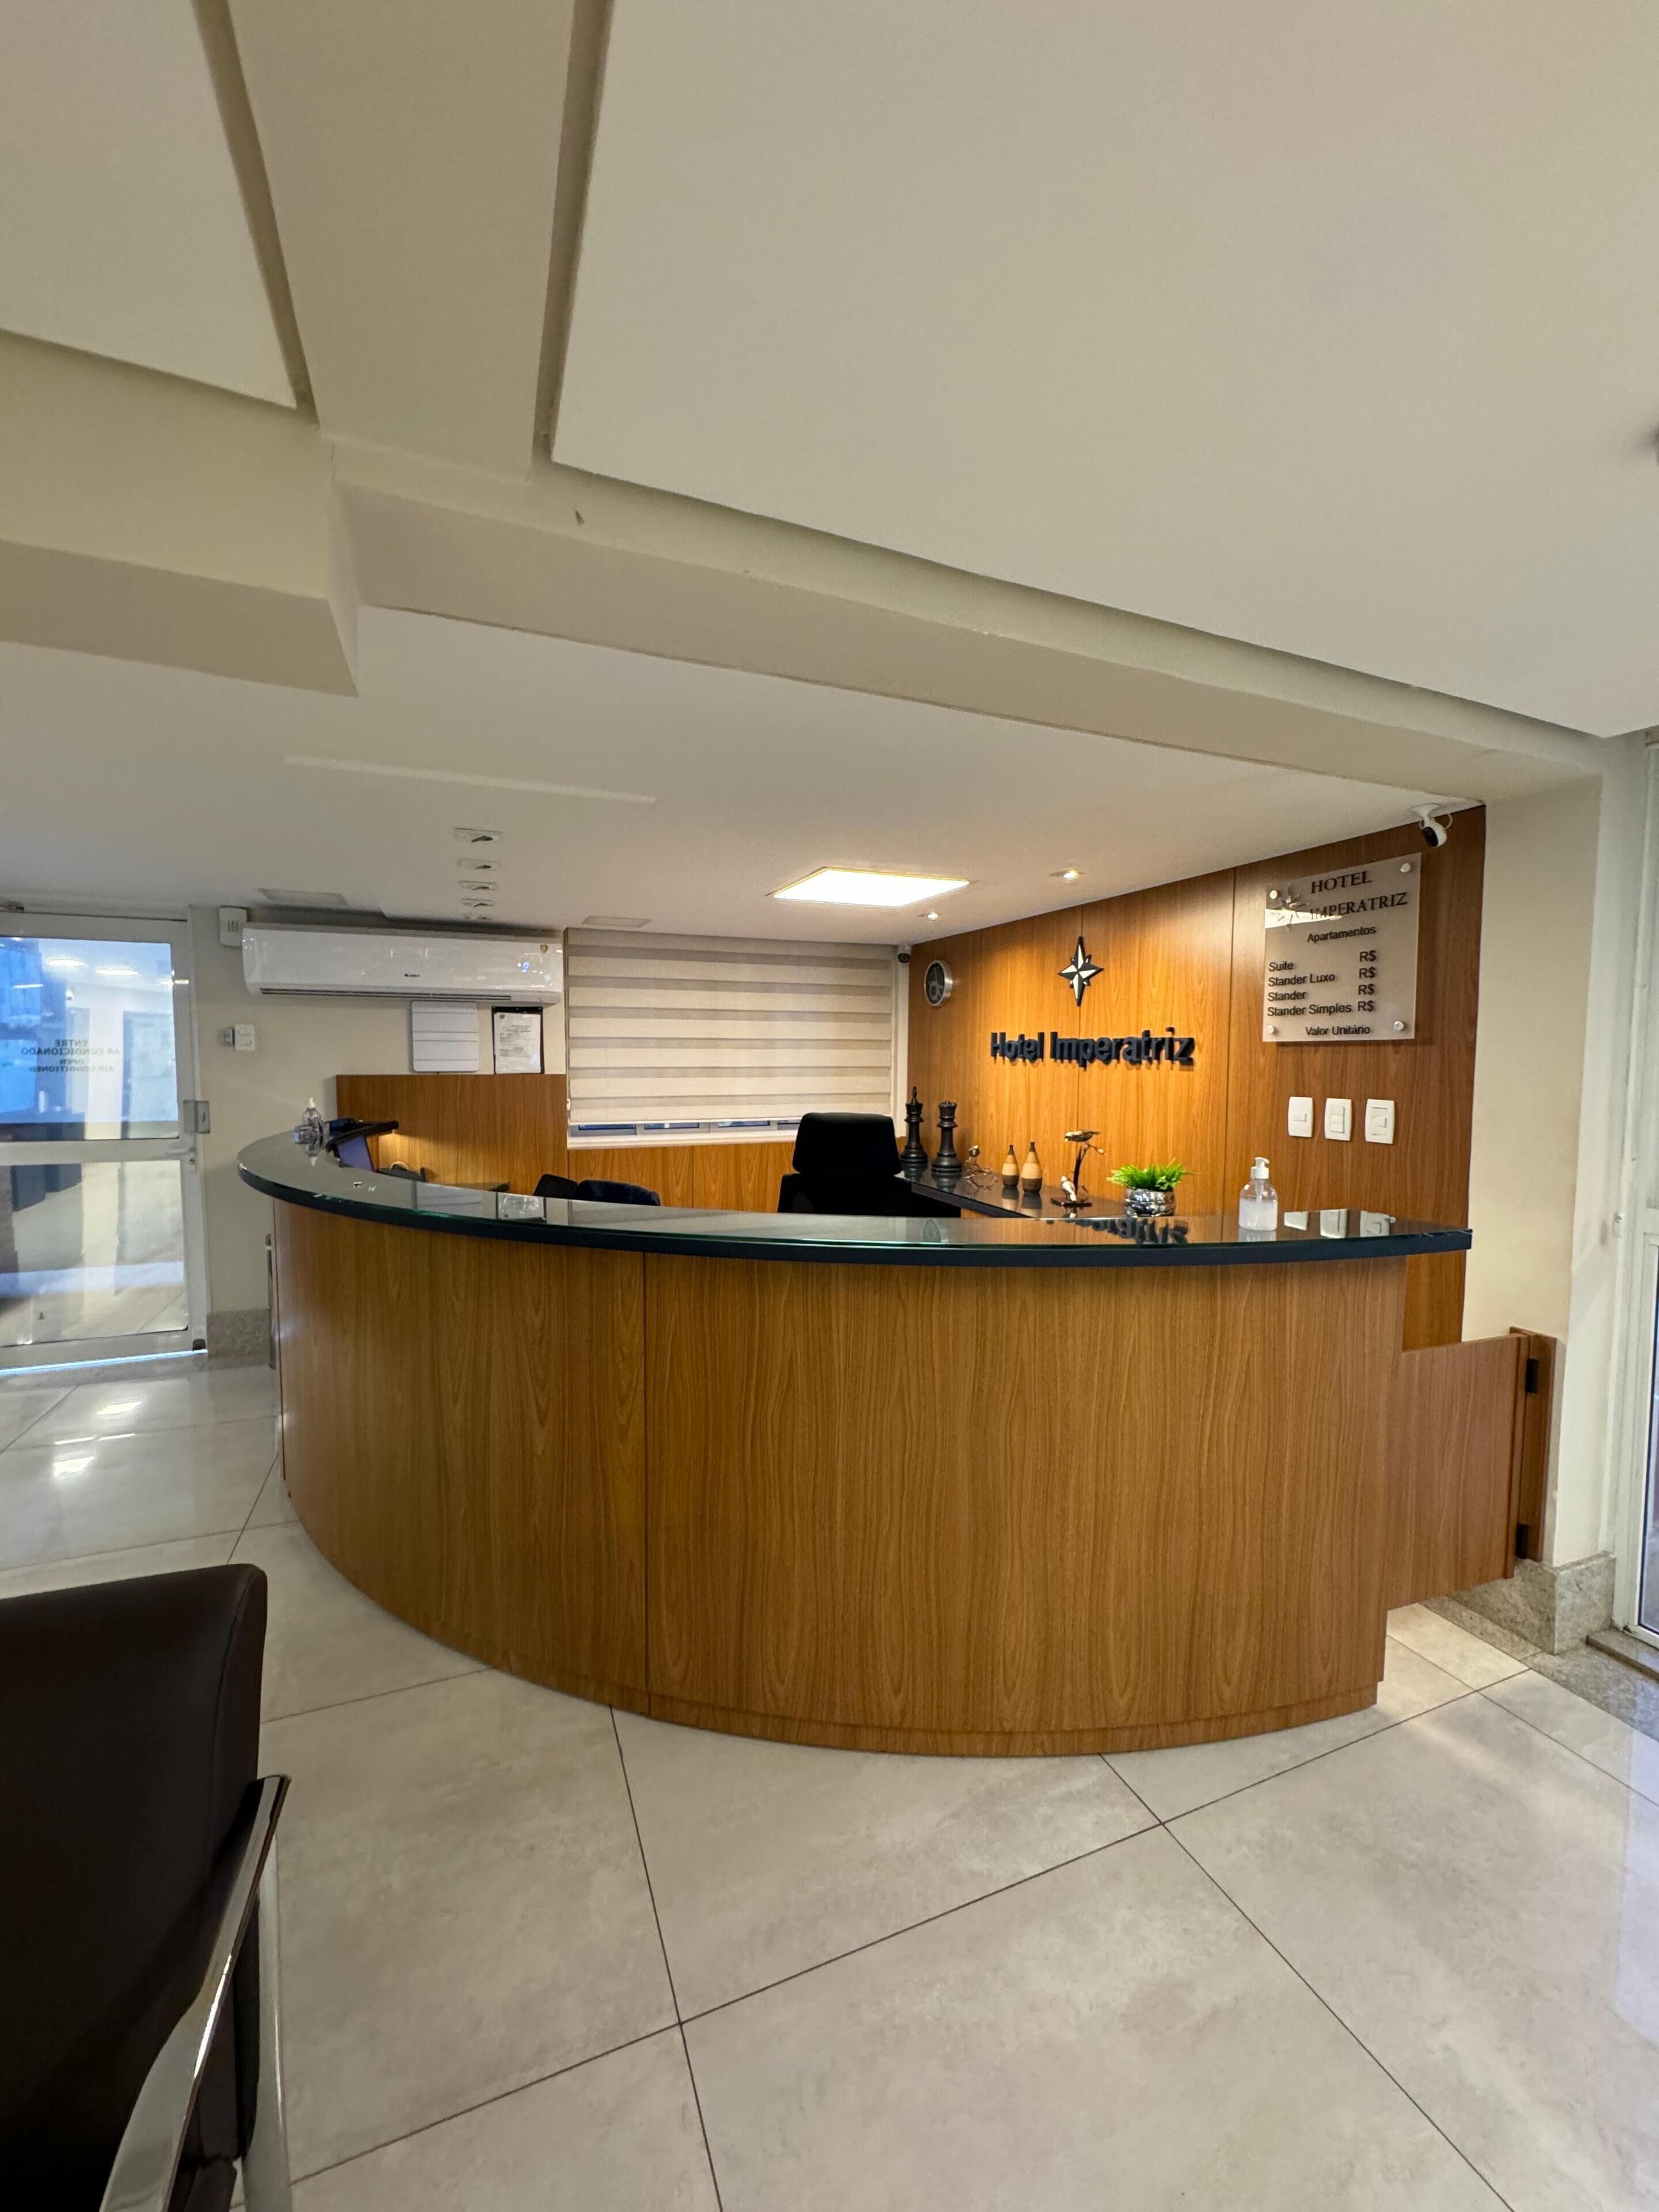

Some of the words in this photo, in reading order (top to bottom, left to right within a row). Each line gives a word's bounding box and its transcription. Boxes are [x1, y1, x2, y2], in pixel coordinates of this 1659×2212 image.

[1310, 870, 1373, 893] HOTEL
[1310, 892, 1408, 919] IMPERATRIZ
[1307, 926, 1377, 943] Apartamentos
[1359, 950, 1377, 962] R$
[1268, 975, 1307, 987] Stander
[1310, 974, 1336, 983] Luxo
[1359, 967, 1376, 979] R$
[1268, 991, 1306, 1001] Stander
[1358, 983, 1376, 996] R$
[1267, 1006, 1306, 1017] Stander
[1309, 1003, 1352, 1016] Simples
[1357, 1000, 1375, 1012] R$
[1305, 1027, 1329, 1036] Valor
[991, 1032, 1045, 1062] Hotel
[1050, 1027, 1195, 1069] Imperatriz
